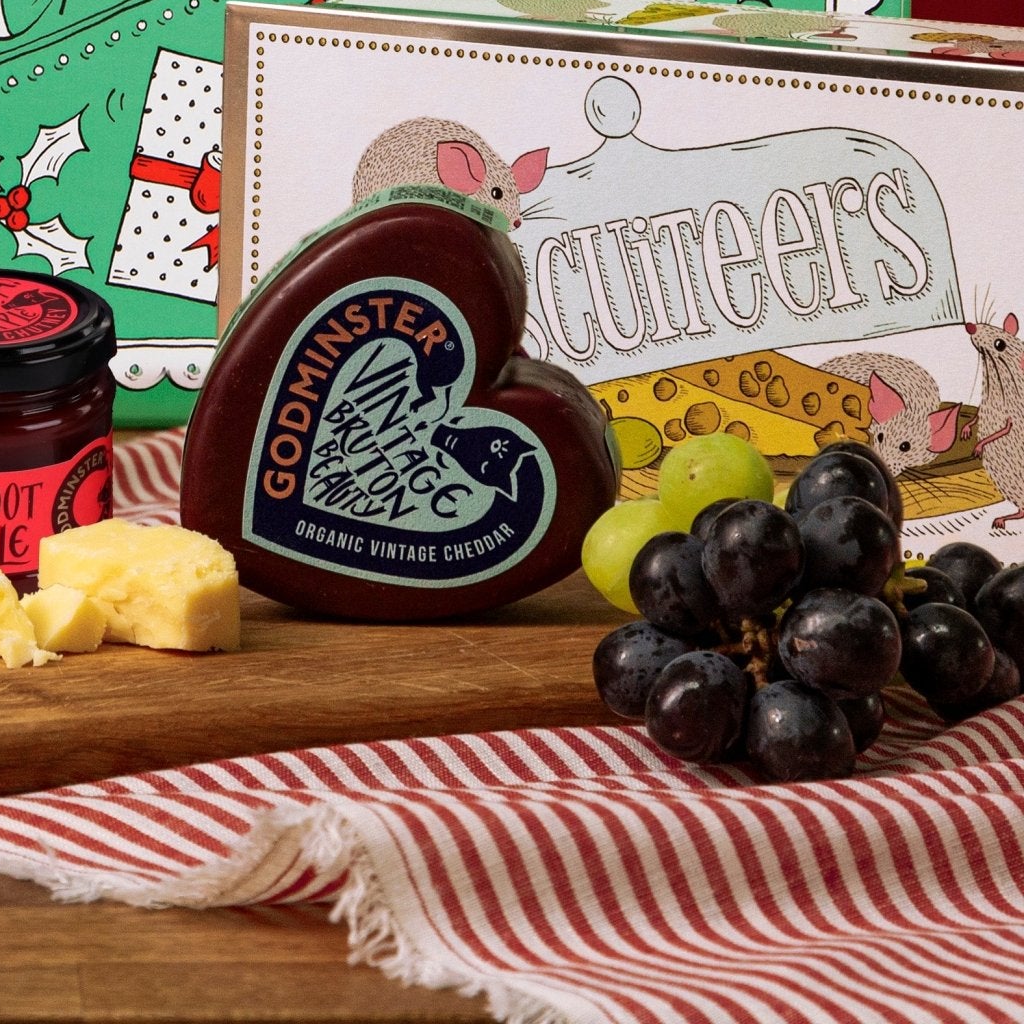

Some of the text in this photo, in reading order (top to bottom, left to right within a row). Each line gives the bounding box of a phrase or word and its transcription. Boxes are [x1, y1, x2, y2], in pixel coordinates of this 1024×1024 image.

[2, 308, 67, 340] CHUTNEY
[263, 297, 447, 500] GODMINSTER
[343, 342, 474, 519] VINTAGE
[309, 438, 387, 517] BEAUTY
[323, 398, 419, 521] BRUTON
[295, 520, 515, 562] ORGANIC VINTAGE CHEDDAR
